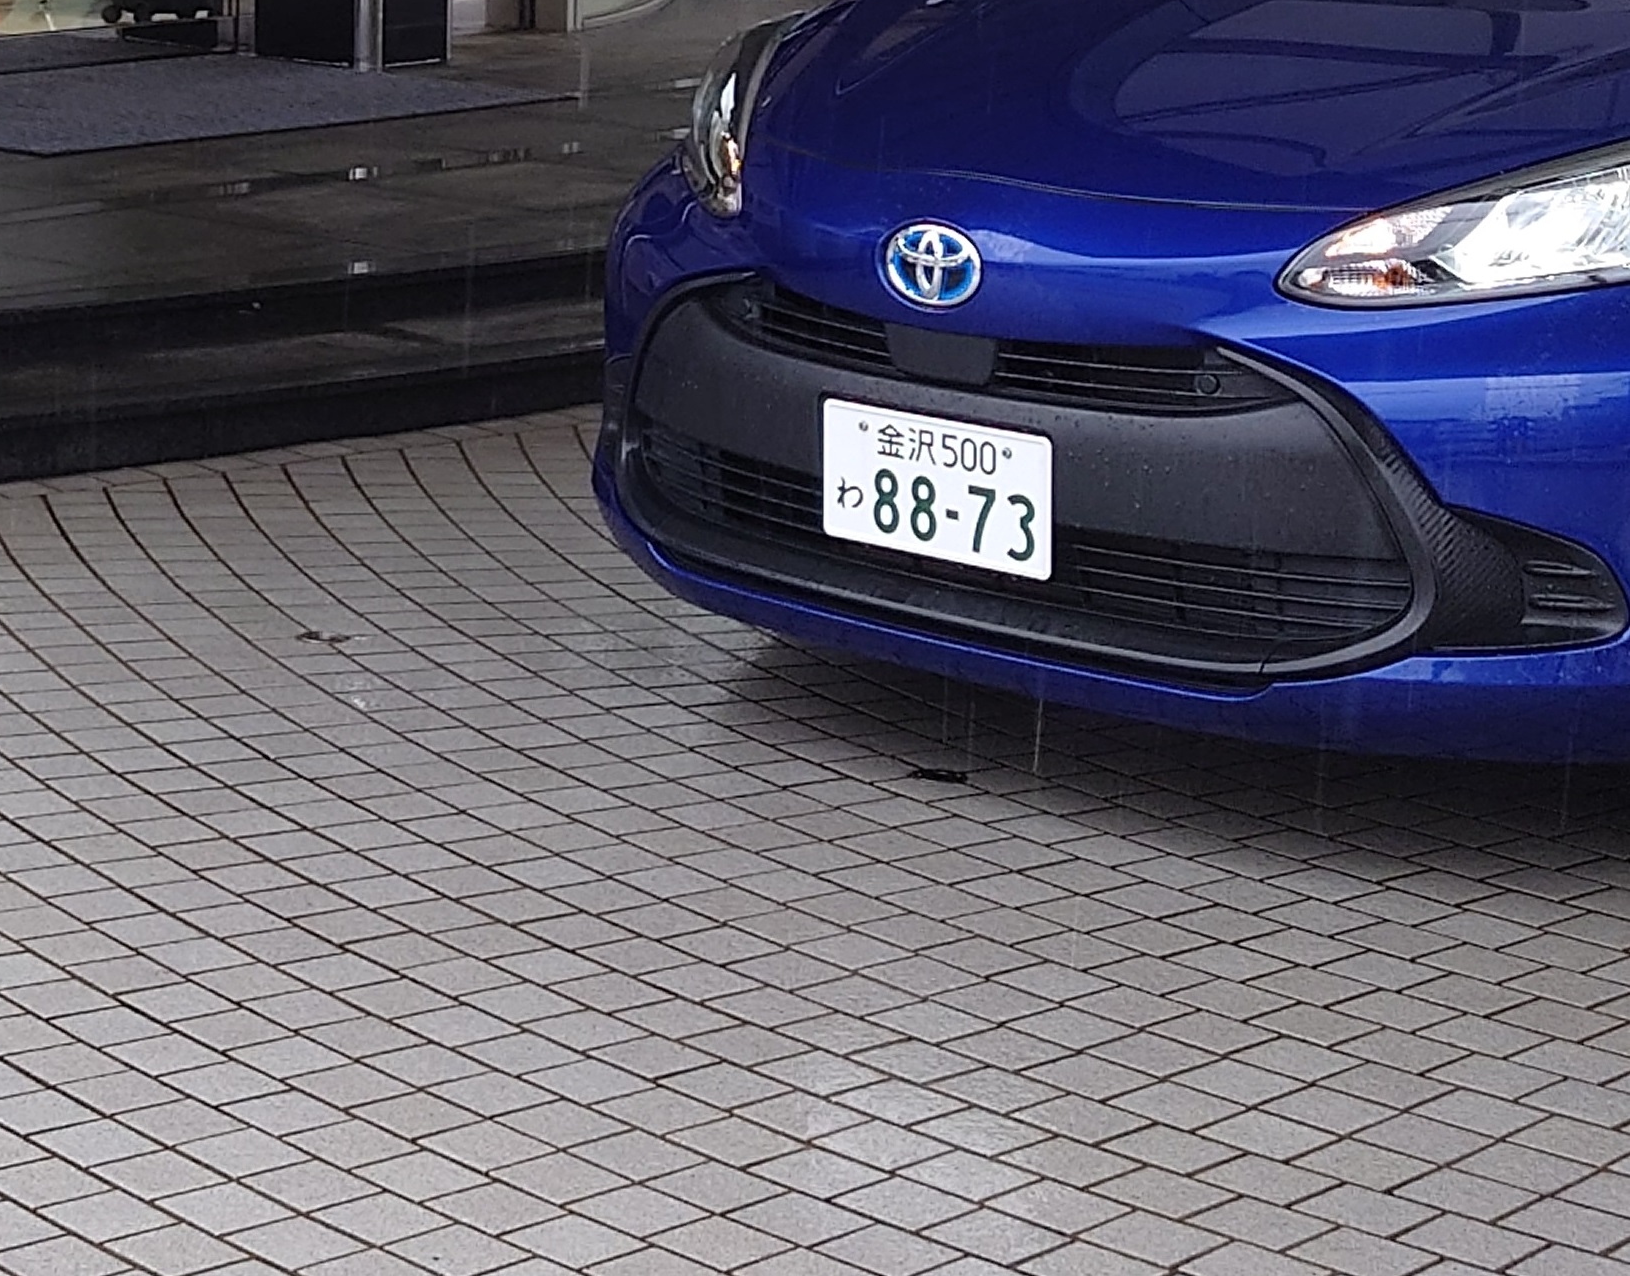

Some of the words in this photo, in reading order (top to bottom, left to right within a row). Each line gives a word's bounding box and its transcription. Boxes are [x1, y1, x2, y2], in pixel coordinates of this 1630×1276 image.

[876, 423, 997, 476] 金沢500
[835, 476, 865, 509] わ
[872, 467, 1036, 562] 88-73
